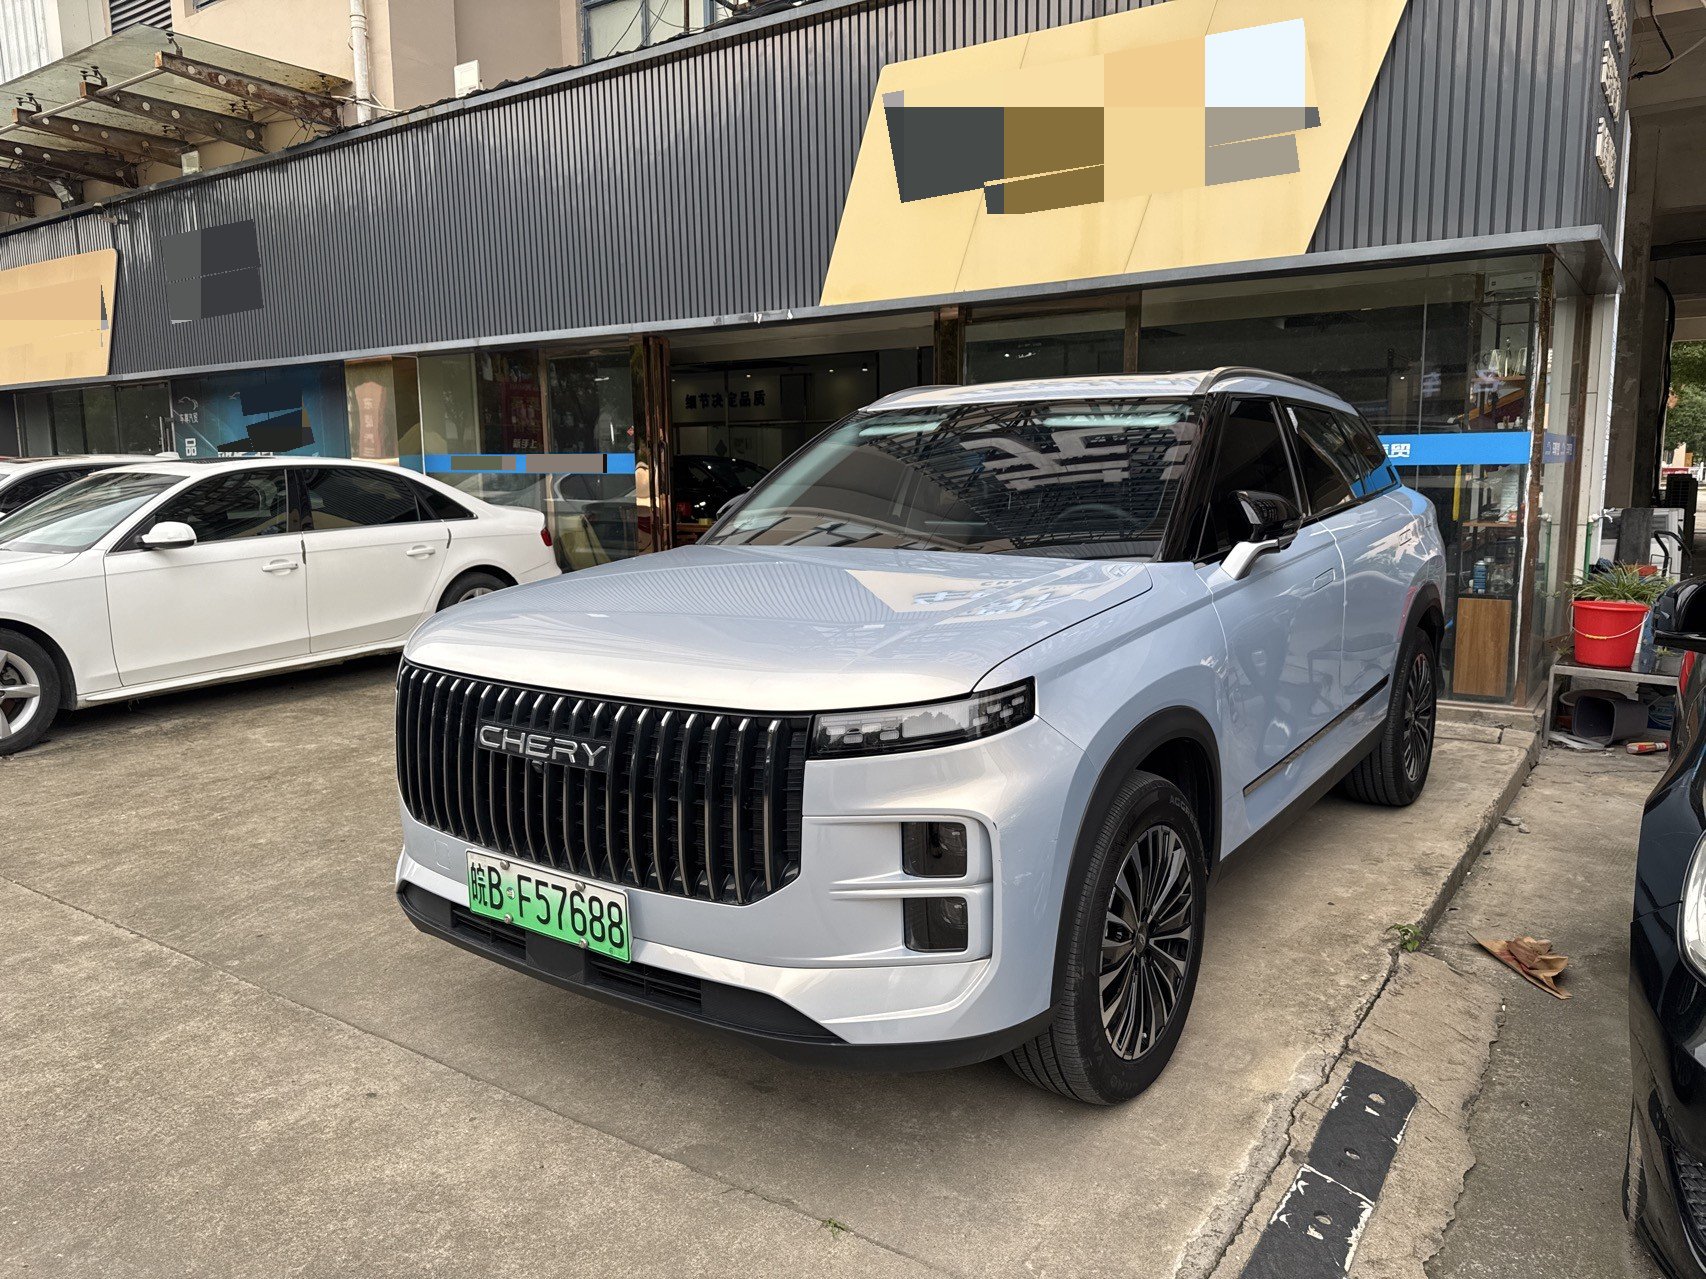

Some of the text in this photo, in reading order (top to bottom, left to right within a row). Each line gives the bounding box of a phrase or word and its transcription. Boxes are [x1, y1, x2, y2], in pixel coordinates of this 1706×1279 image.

[685, 390, 766, 410] 细节决定品质
[480, 725, 606, 766] CHERY
